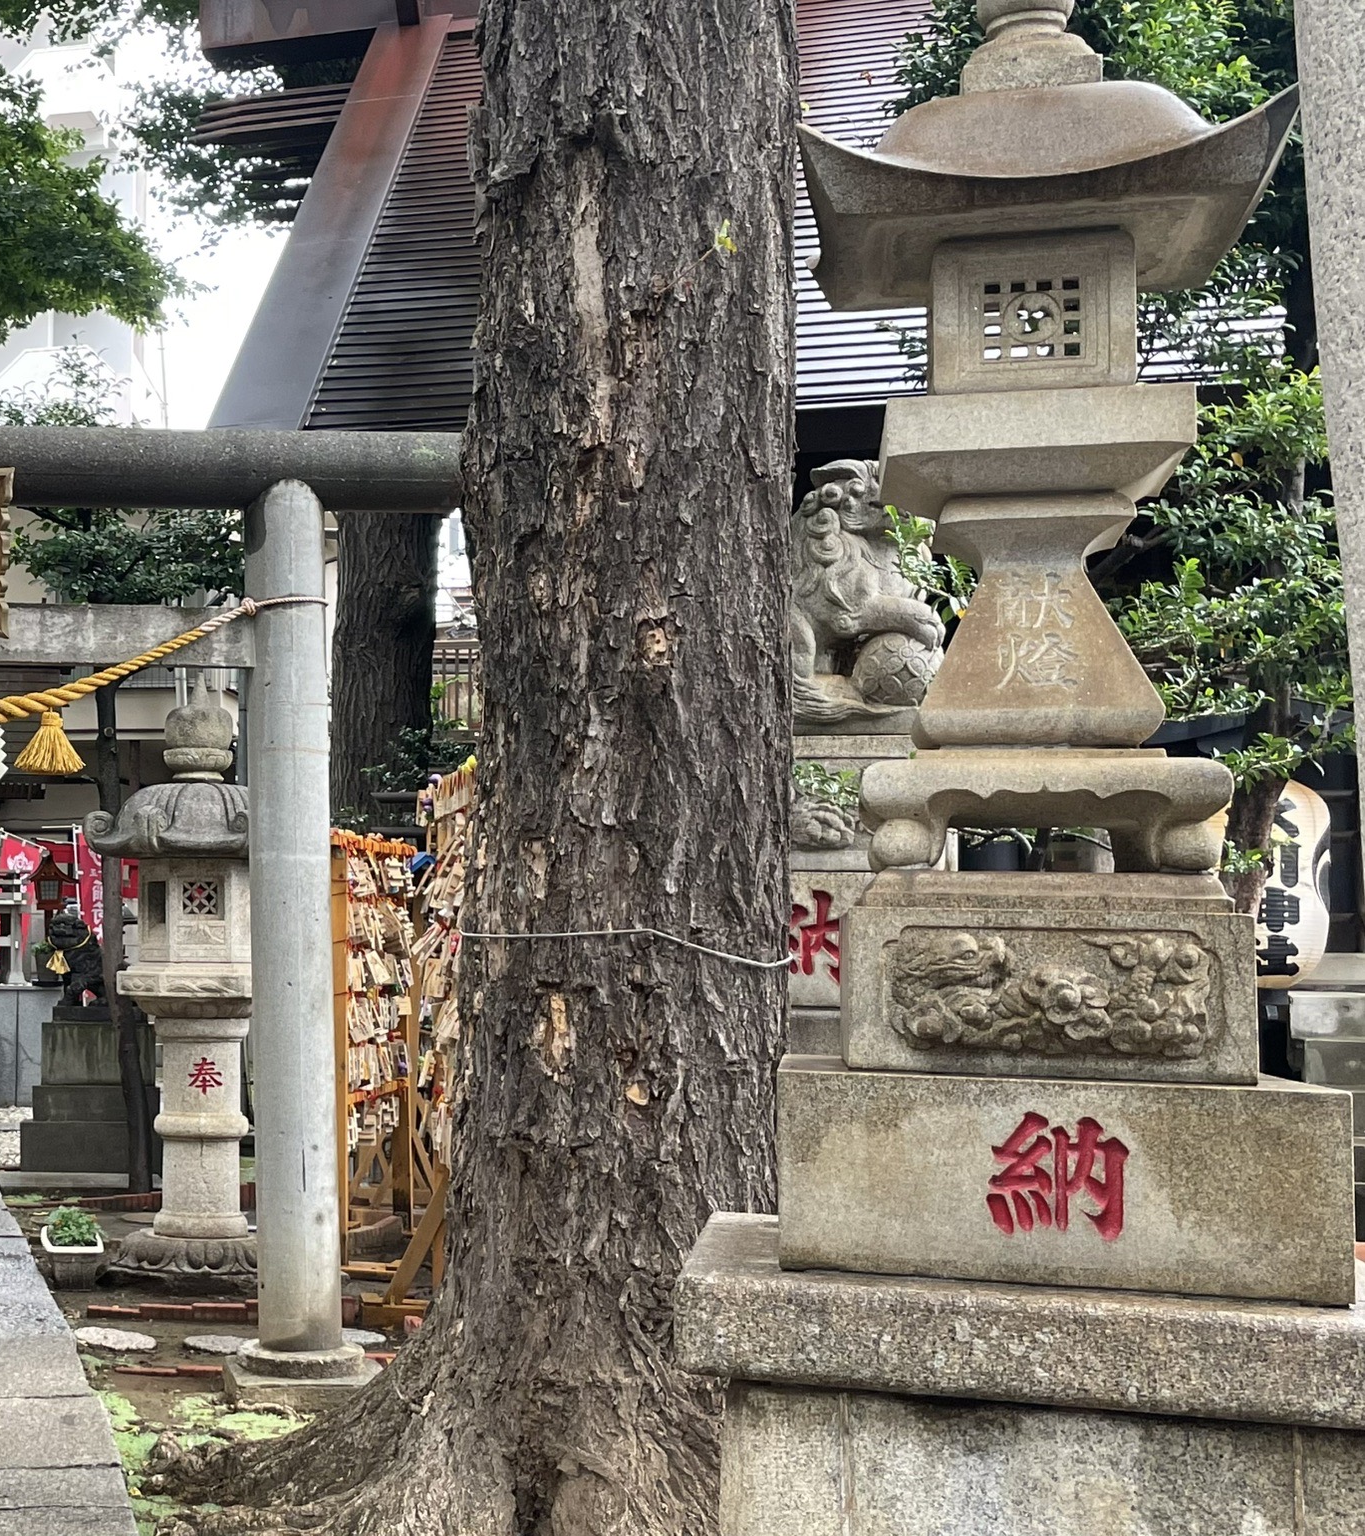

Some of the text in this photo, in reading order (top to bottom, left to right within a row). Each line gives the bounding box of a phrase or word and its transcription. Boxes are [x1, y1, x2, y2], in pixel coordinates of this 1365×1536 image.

[995, 571, 1079, 691] 献燈
[187, 1056, 223, 1096] 奉
[985, 1110, 1130, 1241] 納
